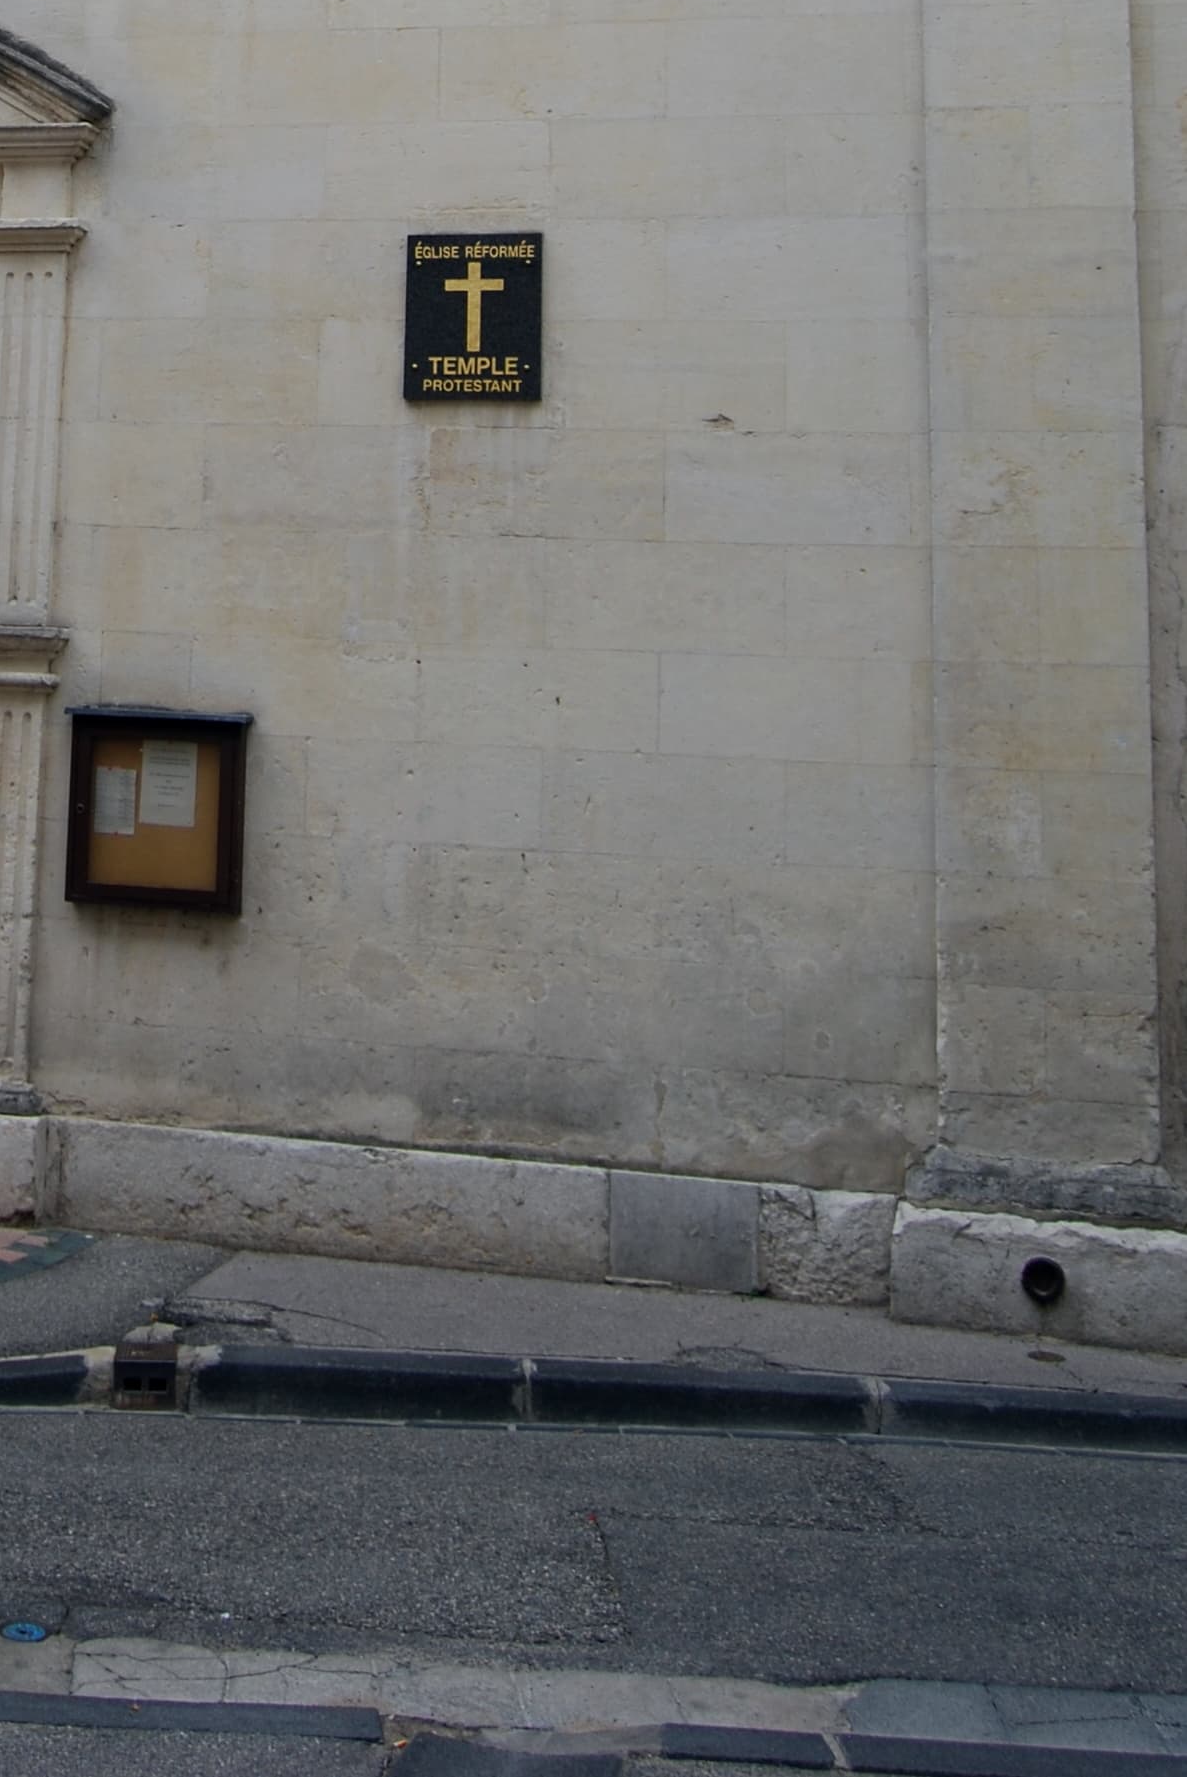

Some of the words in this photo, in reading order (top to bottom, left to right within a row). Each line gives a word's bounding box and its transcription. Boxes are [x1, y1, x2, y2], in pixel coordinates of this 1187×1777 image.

[415, 241, 459, 260] ÉGLISE
[465, 240, 535, 259] RÉFORMÉE
[428, 356, 518, 376] TEMPLE
[422, 379, 522, 393] PROTESTANT
